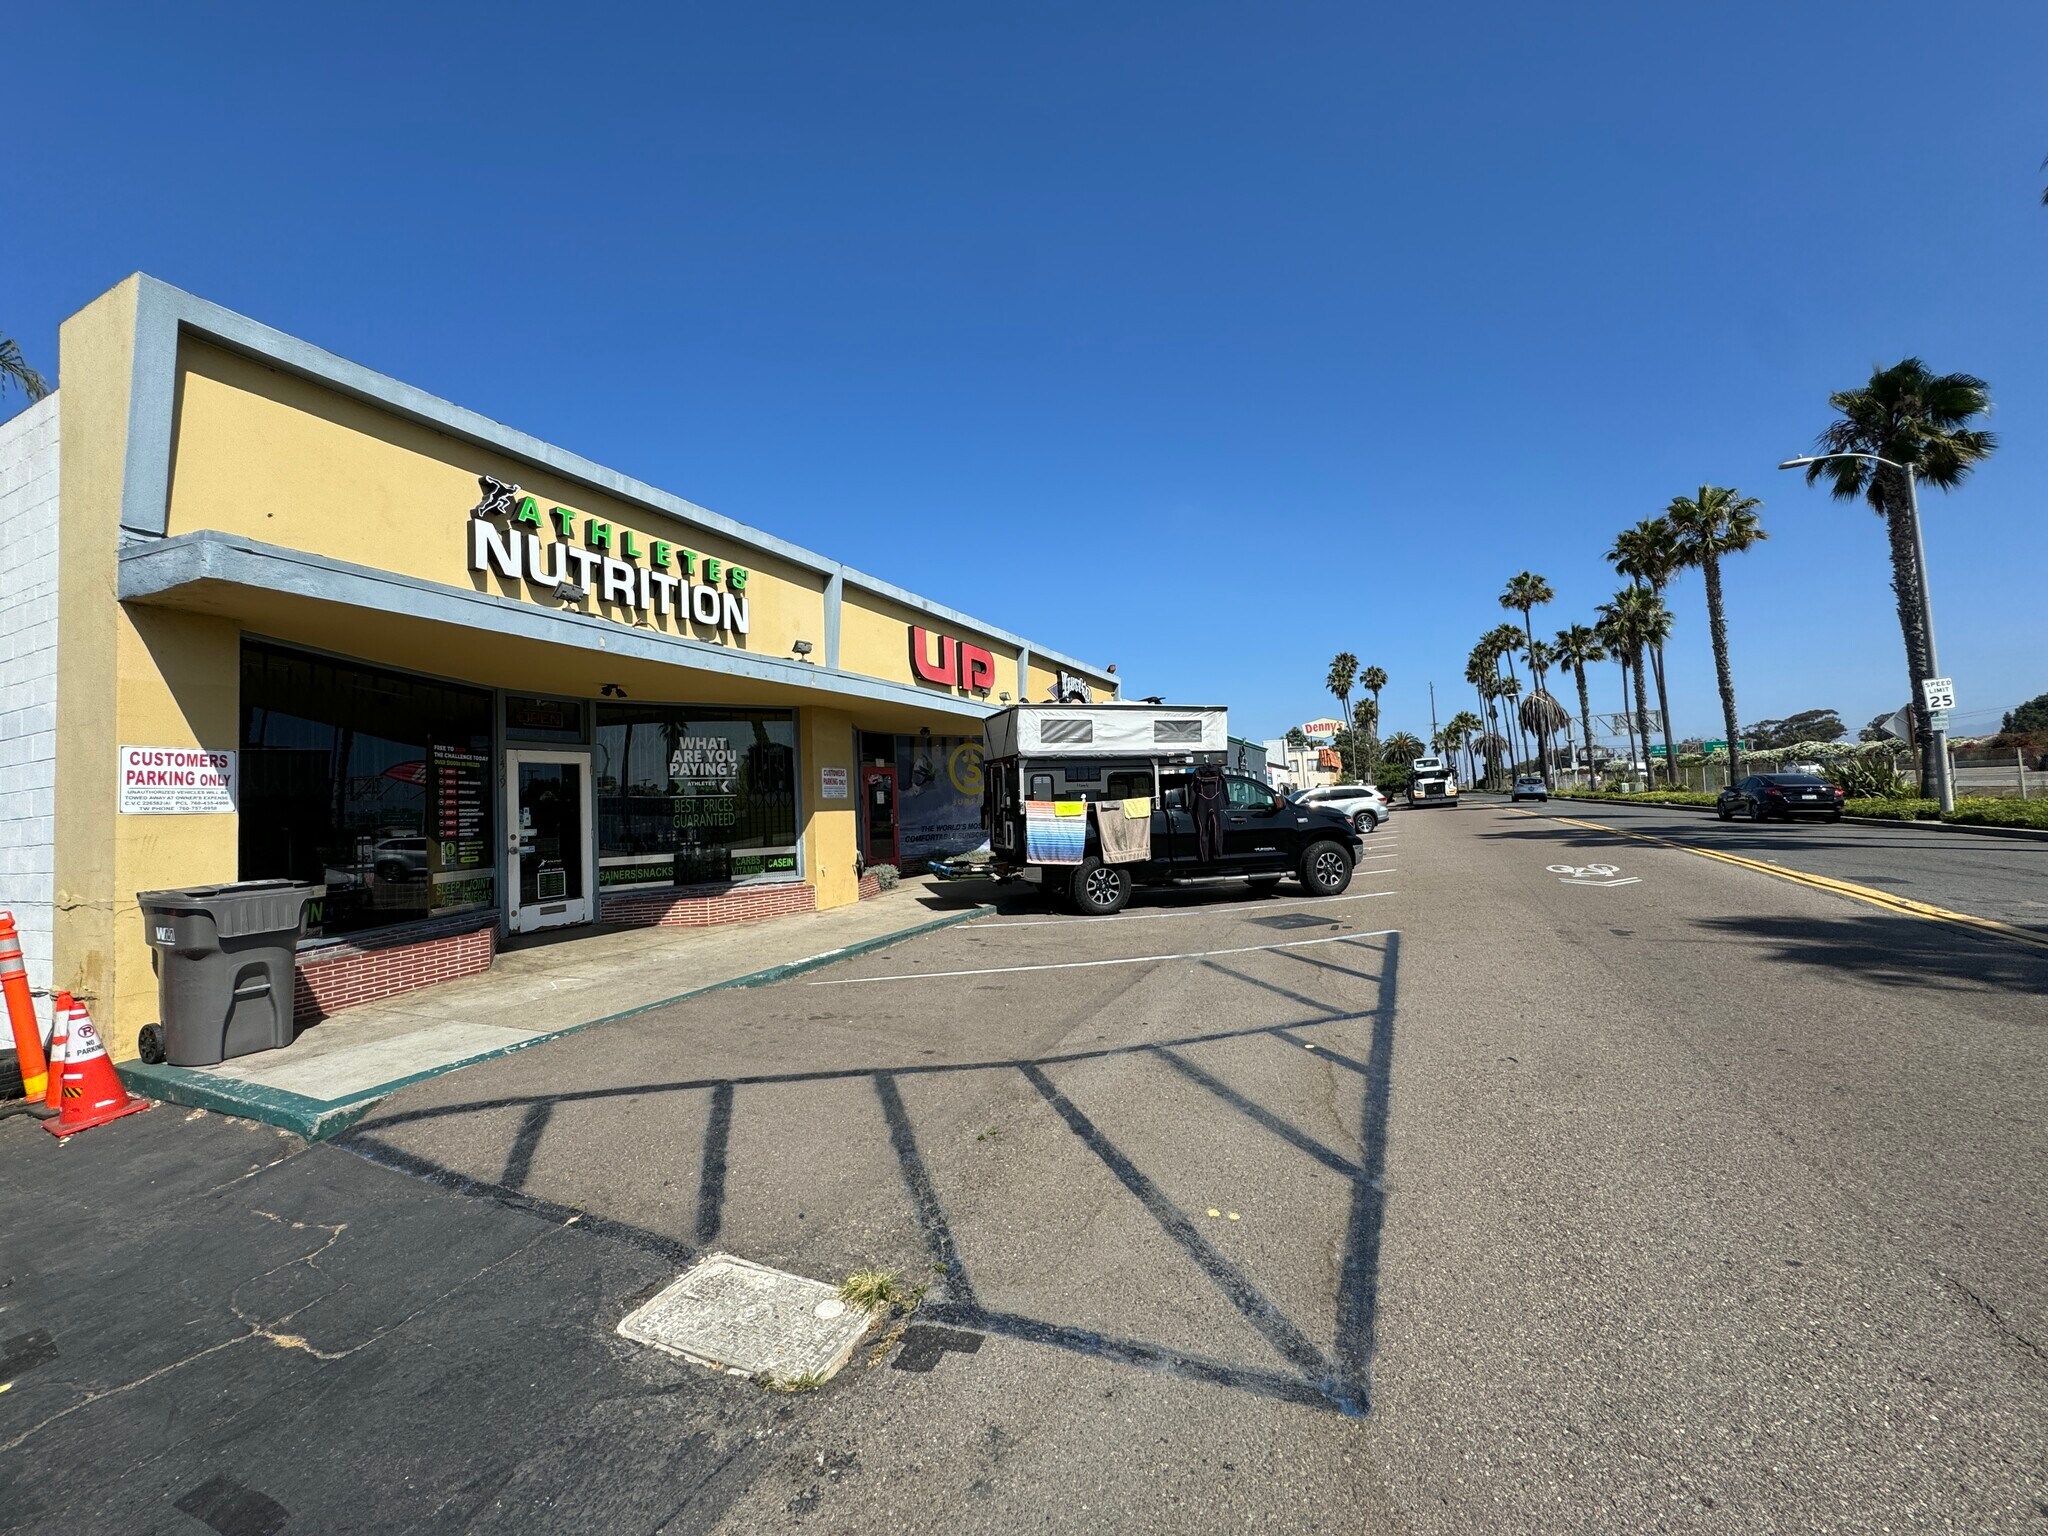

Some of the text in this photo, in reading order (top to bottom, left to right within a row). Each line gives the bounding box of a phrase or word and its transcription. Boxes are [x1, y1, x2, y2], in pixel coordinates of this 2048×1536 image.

[474, 519, 750, 634] NUTRITION
[913, 625, 995, 691] UP
[1925, 680, 1951, 688] SPEED
[1929, 694, 1953, 708] 25
[1304, 721, 1343, 734] Denny's
[433, 744, 446, 752] FREE
[679, 736, 727, 750] WHAT
[129, 751, 228, 769] CUSTOMERS
[672, 750, 737, 762] ARE YOU
[669, 763, 727, 776] PAYING
[126, 770, 231, 787] PARKING ONLY
[674, 798, 734, 813] BEST PRICES
[672, 813, 736, 828] GUARANTEED
[921, 825, 935, 833] THE
[936, 823, 967, 832] WORLD'S
[905, 832, 957, 843] COMFORTABLE
[735, 856, 761, 865] CARBS
[767, 857, 794, 868] CASEIN
[599, 869, 636, 881] GAINERS
[637, 866, 675, 879] SNACKS
[731, 864, 765, 875] VITAMINS
[435, 881, 461, 896] SLEEP
[468, 877, 492, 891] JOINT
[441, 895, 455, 907] AID
[462, 889, 493, 904] OMEGA'S
[86, 1039, 95, 1047] NO
